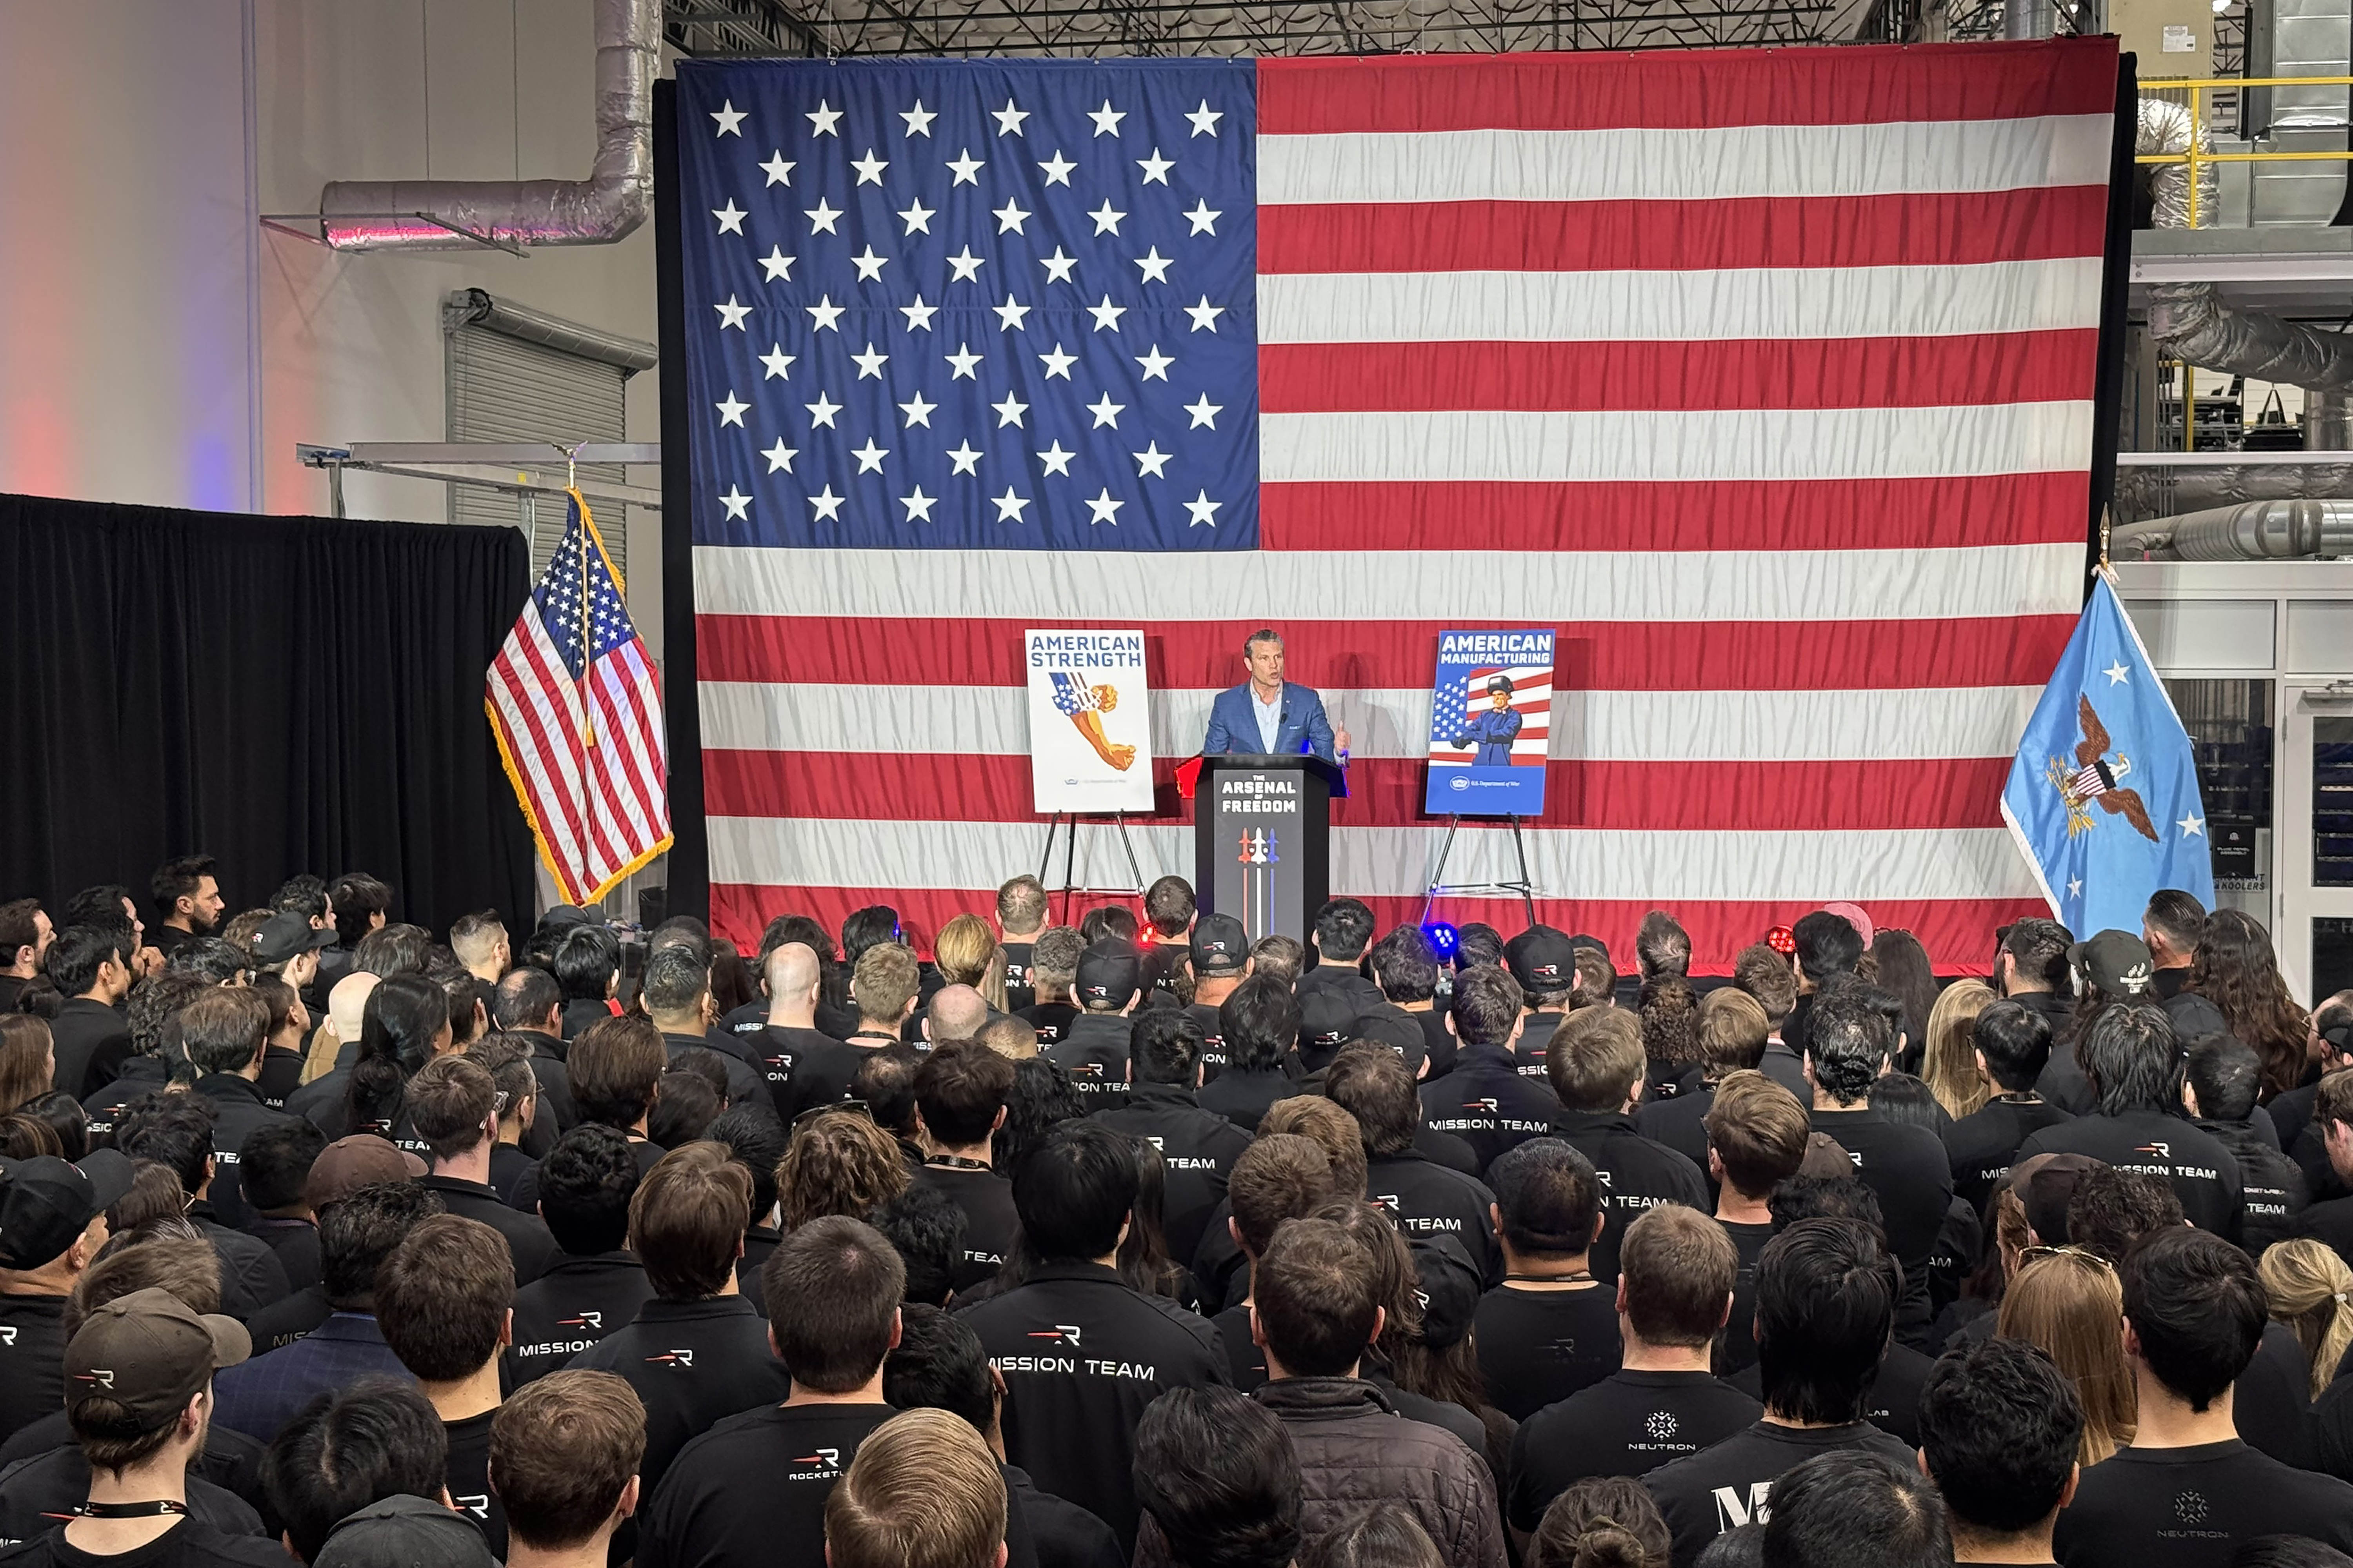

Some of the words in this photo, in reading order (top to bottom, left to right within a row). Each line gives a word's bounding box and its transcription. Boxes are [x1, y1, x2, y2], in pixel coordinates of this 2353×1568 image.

[1031, 636, 1140, 650] AMERICAN
[1441, 634, 1551, 652] AMERICAN
[1031, 653, 1141, 666] STRENGTH
[1441, 652, 1551, 664] MANUFACTURING
[1222, 781, 1296, 793] ARSENAL
[1222, 800, 1296, 812] FREEDOM
[734, 1022, 766, 1032] MISSI
[1104, 1082, 1130, 1091] TEA
[1429, 1119, 1494, 1131] MISSION
[1501, 1120, 1547, 1133] TEAM
[395, 1140, 430, 1150] TEA
[1167, 1158, 1215, 1169] TEAM
[2175, 1166, 2217, 1179] TEAM
[1616, 1196, 1667, 1209] TEAM
[2247, 1203, 2285, 1214] TEAM
[1405, 1218, 1461, 1230] TEAM
[964, 1250, 1002, 1264] TEA
[1085, 1360, 1154, 1381] TEAM
[2157, 1530, 2229, 1538] NEUTRON
